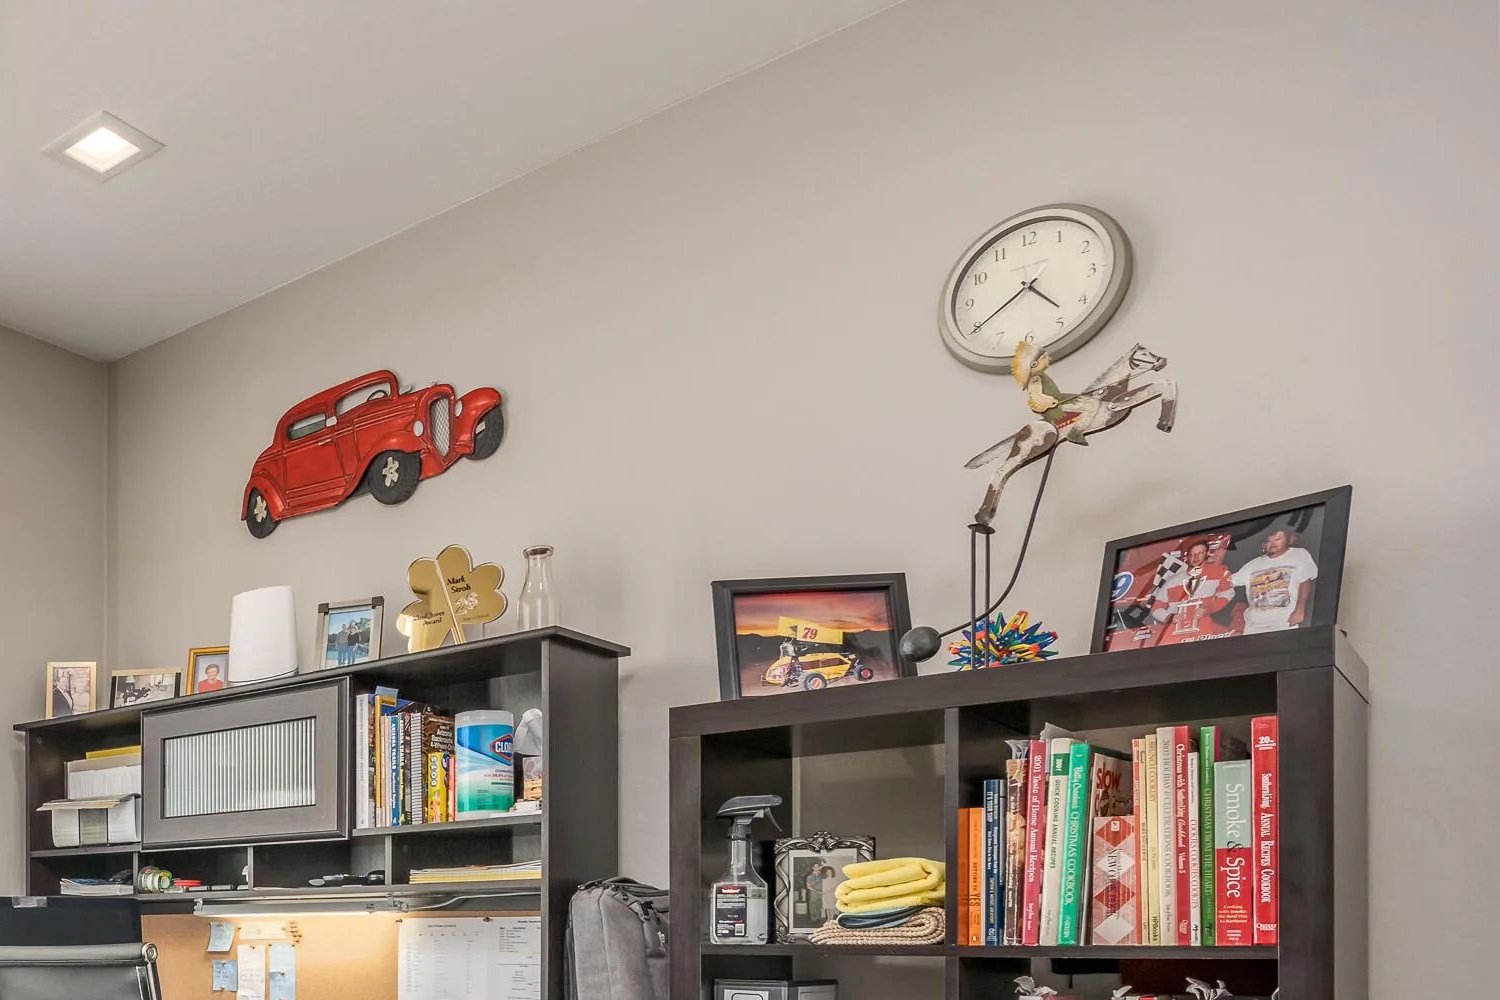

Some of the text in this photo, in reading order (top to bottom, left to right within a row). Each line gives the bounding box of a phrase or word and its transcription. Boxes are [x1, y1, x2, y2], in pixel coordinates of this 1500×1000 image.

[1021, 231, 1037, 247] 12
[1057, 231, 1062, 243] 1
[1081, 240, 1090, 254] 2
[994, 248, 1006, 262] 11
[1087, 263, 1097, 278] 3
[973, 272, 987, 285] 10
[966, 298, 974, 311] 9
[1078, 295, 1087, 304] 4
[973, 321, 982, 334] 8
[1055, 317, 1064, 330] 5
[996, 332, 1005, 345] 7
[1024, 331, 1034, 343] 6
[447, 575, 465, 585] Mark
[451, 584, 471, 594] Stroh
[801, 626, 819, 641] 79
[1225, 783, 1247, 838] Smoke
[1028, 755, 1042, 883] 2001 Taste of Home Annual Recipes
[1226, 840, 1243, 853] &
[1220, 857, 1246, 898] Spice
